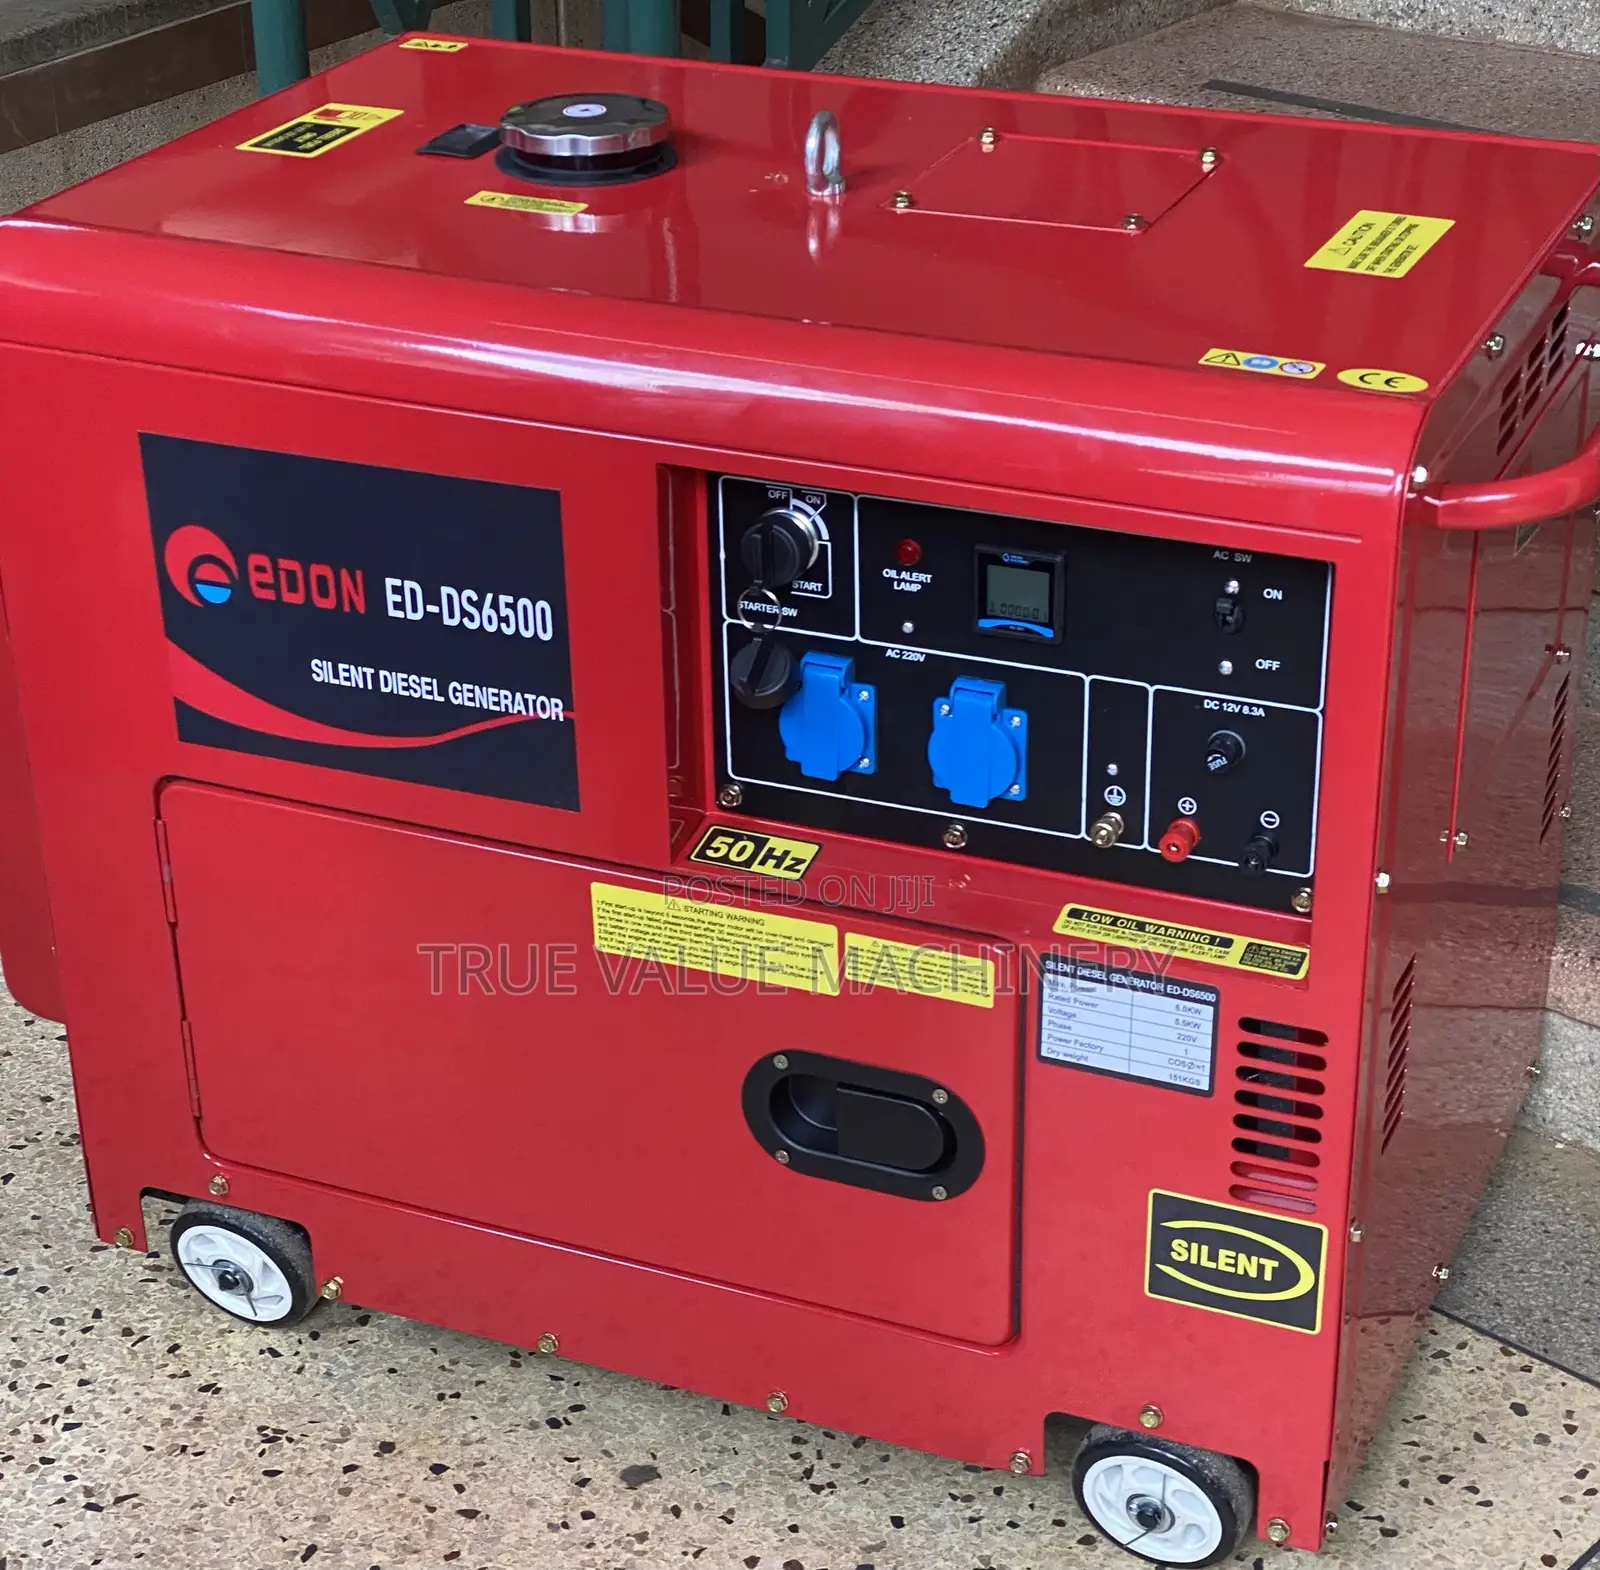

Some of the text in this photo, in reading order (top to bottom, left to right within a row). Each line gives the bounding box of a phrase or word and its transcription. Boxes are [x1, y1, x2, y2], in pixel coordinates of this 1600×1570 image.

[1358, 372, 1406, 389] CE
[768, 489, 788, 500] OFF
[805, 495, 821, 505] ON
[1213, 550, 1252, 563] AC SW
[882, 568, 933, 584] OIL ALERT
[792, 580, 823, 592] START
[894, 580, 922, 593] LAMP
[1263, 588, 1283, 601] ON
[385, 576, 553, 642] ED-DS6500
[781, 606, 798, 618] SW
[885, 648, 926, 663] AC 220V
[1255, 659, 1281, 672] OFF
[310, 658, 565, 722] SILENT DIESEL GENERATOR
[1203, 699, 1266, 718] DC 12V 8.3A
[705, 835, 808, 874] 50 Hz
[684, 905, 764, 926] STARTING WARNING
[1081, 912, 1114, 922] LOW
[1116, 918, 1140, 930] OIL
[1143, 924, 1211, 944] WARNING
[1045, 960, 1217, 1003] SILENT DIESEL GENERATOR ED-DS6500
[1047, 992, 1100, 1009] Rated Power
[1047, 1006, 1077, 1021] Voltage
[1047, 1019, 1072, 1032] Phase
[1047, 1033, 1105, 1053] Power Factory
[1176, 1032, 1198, 1044] 220V
[1046, 1046, 1089, 1062] Dry weight
[1169, 1237, 1280, 1282] SILENT
